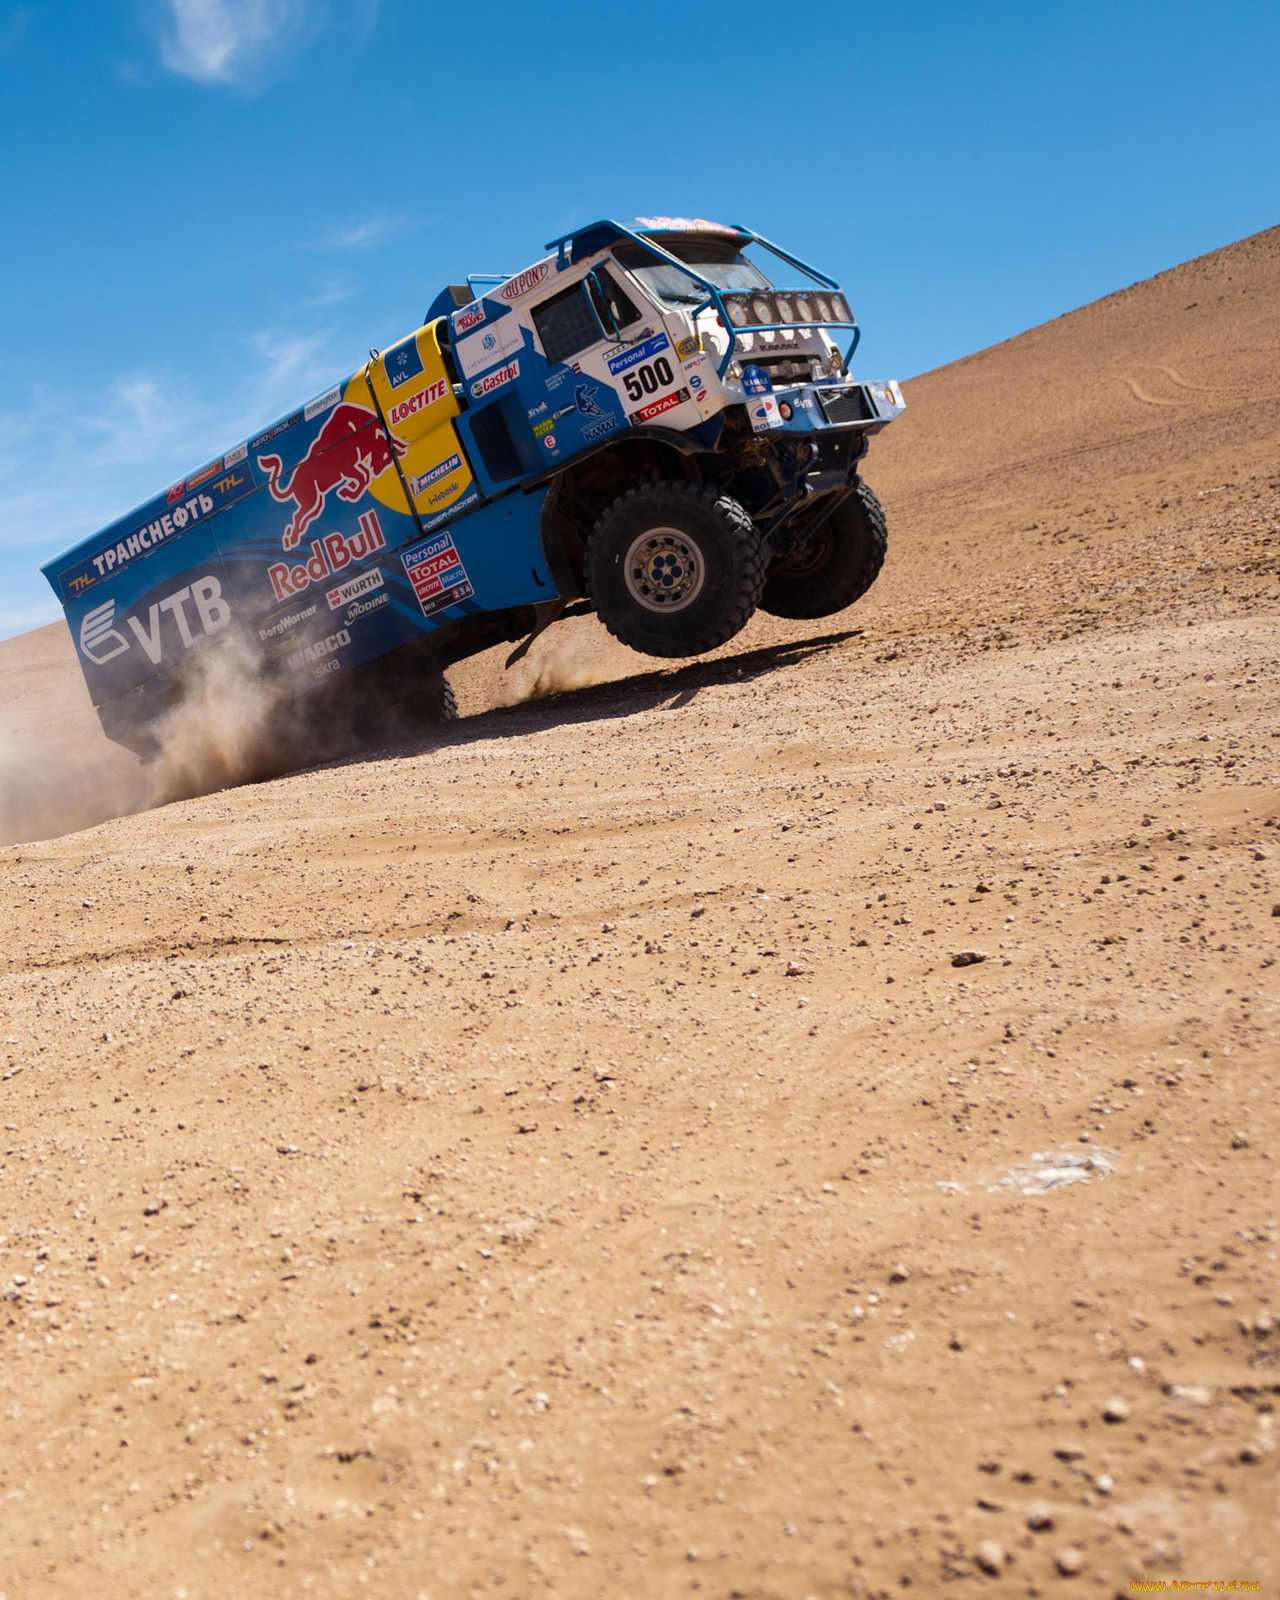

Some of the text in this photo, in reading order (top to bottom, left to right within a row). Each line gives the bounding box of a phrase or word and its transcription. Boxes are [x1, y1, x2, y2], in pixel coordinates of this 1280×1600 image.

[610, 346, 646, 371] Personal
[392, 371, 410, 386] AVL
[483, 363, 518, 392] Castrol
[622, 357, 674, 402] 500
[391, 380, 446, 424] LOCTITE
[640, 397, 678, 418] TOTAL
[584, 417, 618, 442] KAMAZ
[420, 456, 458, 487] MICHELIN
[93, 494, 214, 576] ТРАНСНЕФТЬ
[405, 534, 450, 566] Personal
[268, 509, 386, 602] Red Bull
[410, 555, 457, 580] TOTAL
[341, 572, 381, 599] WÜRTH
[441, 569, 464, 584] Macro
[127, 575, 231, 665] VTB
[348, 593, 389, 619] MODINE
[259, 605, 317, 641] BorgWarner
[287, 629, 352, 670] WABCO
